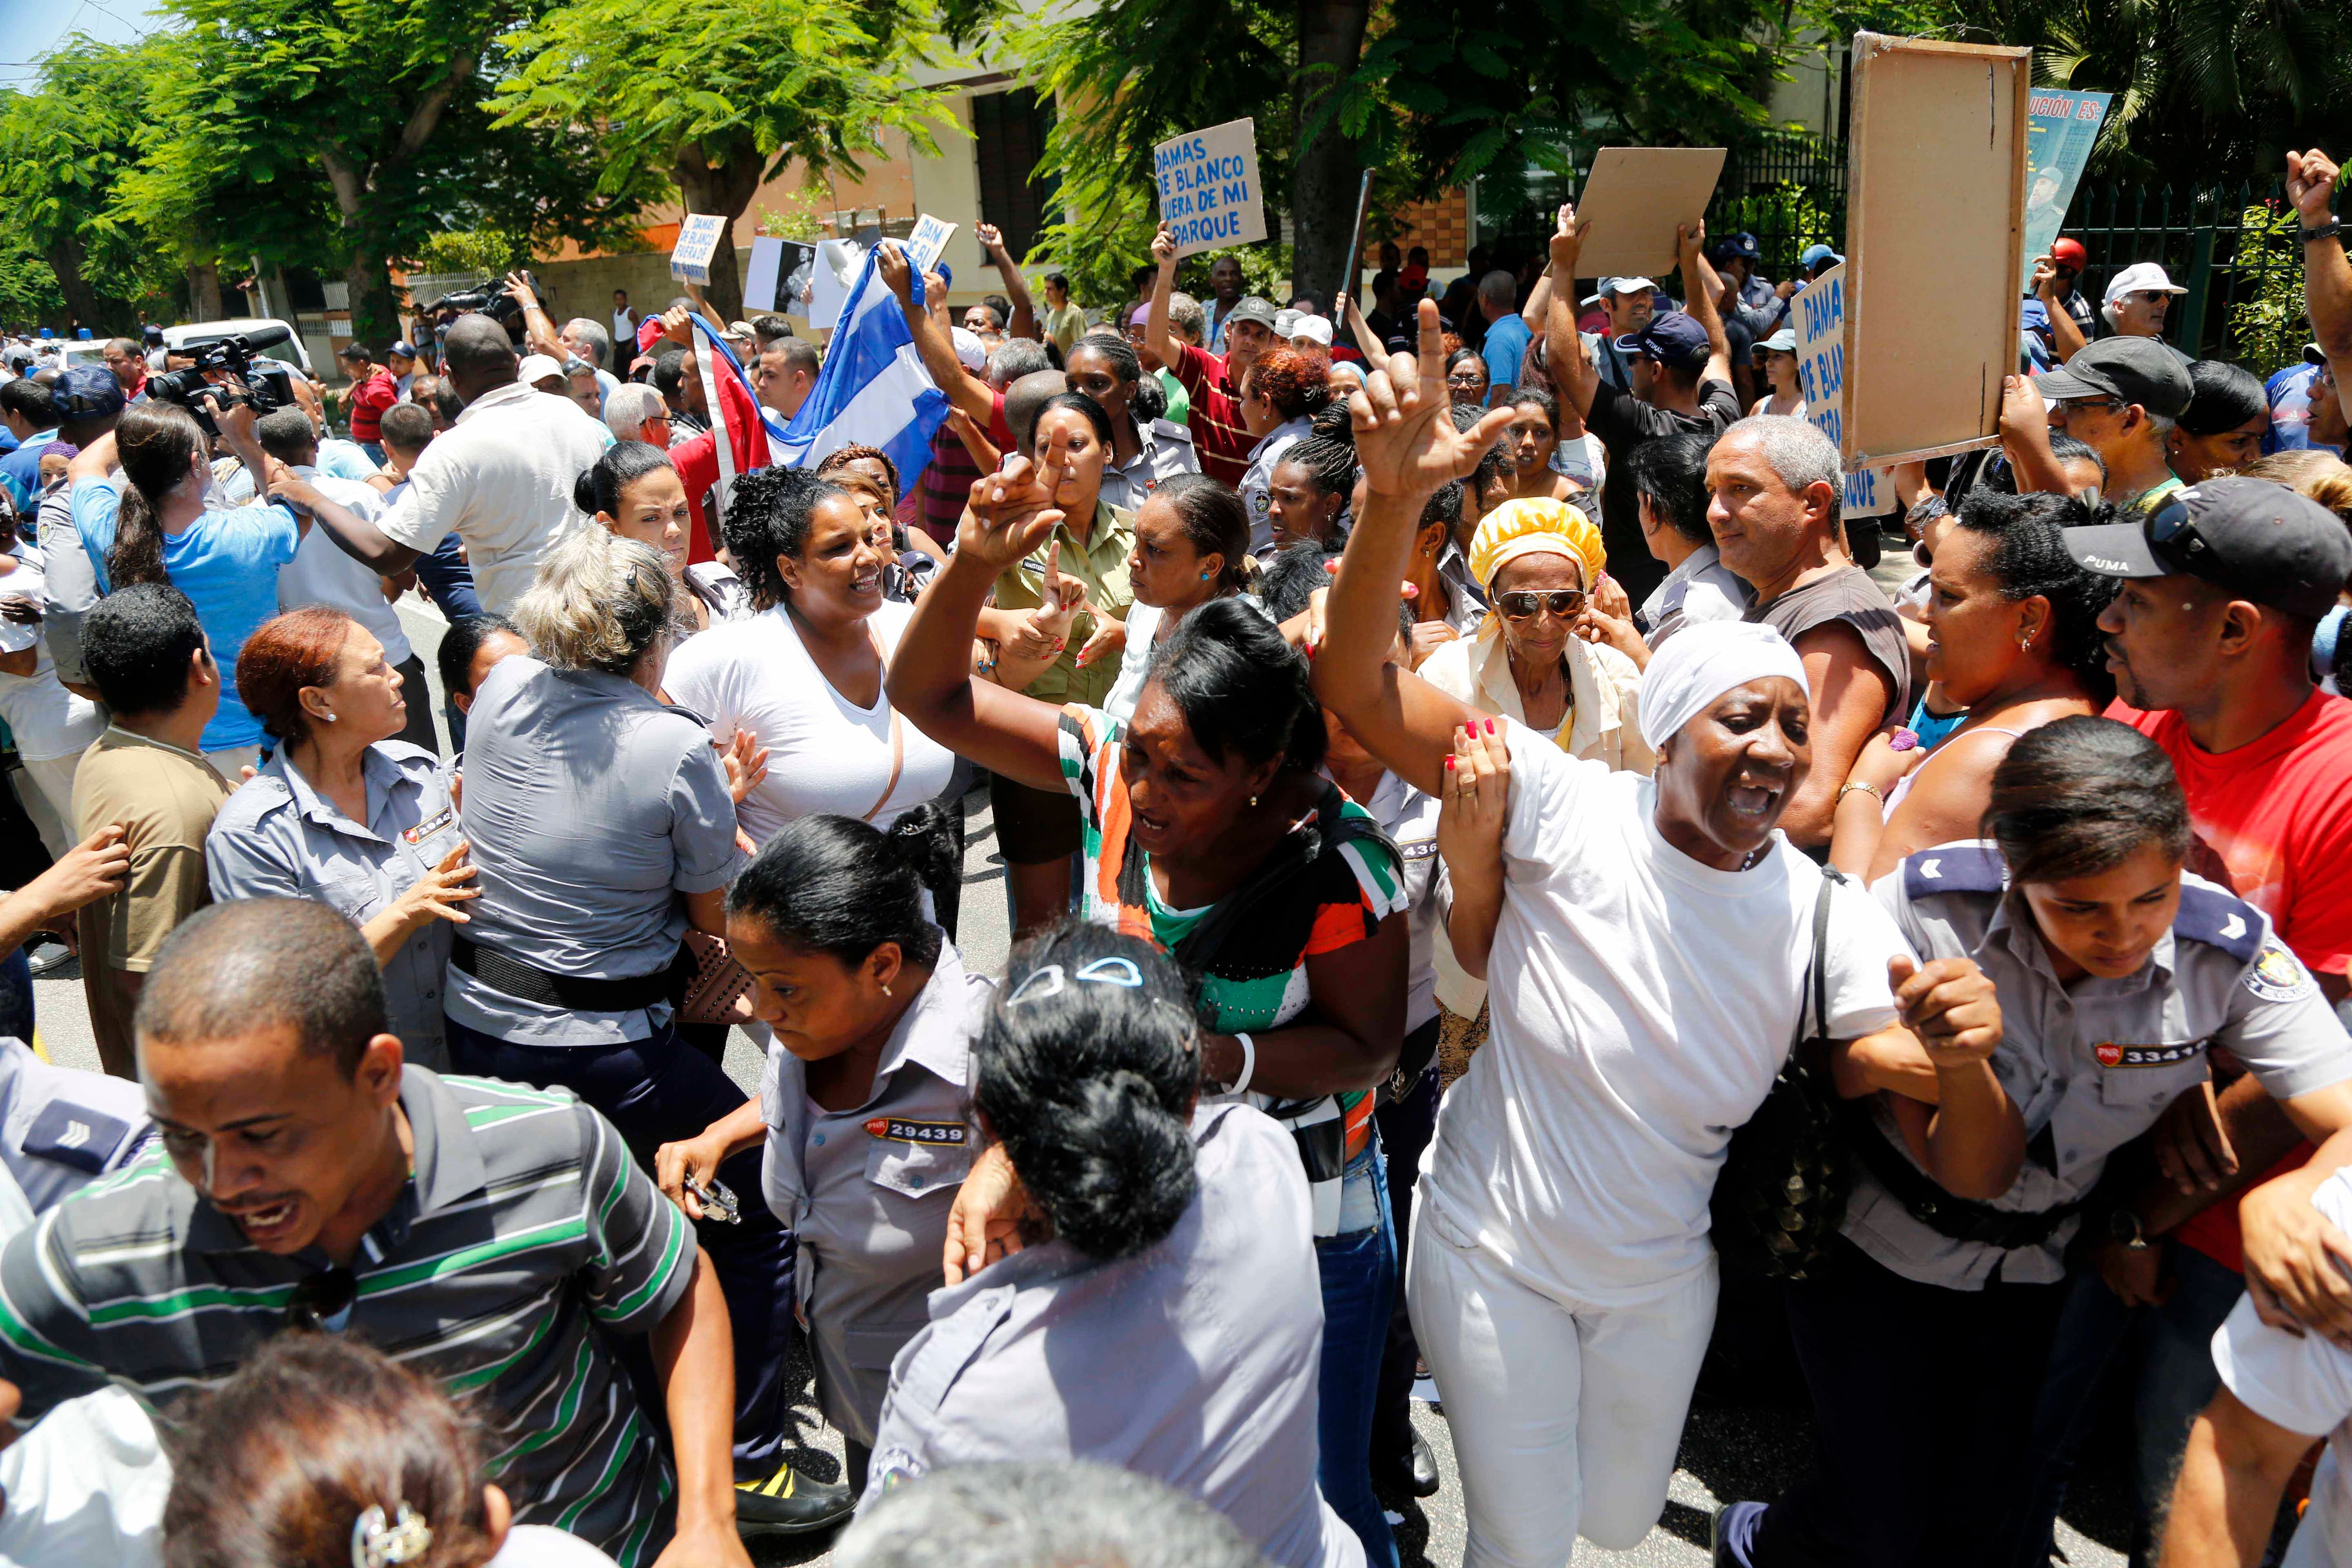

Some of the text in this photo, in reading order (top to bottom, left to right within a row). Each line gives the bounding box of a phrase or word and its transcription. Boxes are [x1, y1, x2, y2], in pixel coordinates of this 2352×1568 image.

[2076, 101, 2102, 120] ES:
[1156, 138, 1207, 173] DAMAS
[1158, 155, 1244, 198] DE BLANCO
[1161, 181, 1248, 221] UERA DE MI
[692, 217, 715, 231] DAMAS
[918, 219, 947, 244] DAM
[1172, 211, 1240, 247] PARQUE
[680, 230, 714, 246] DE BLANCO
[676, 244, 707, 260] FUERA DE
[672, 261, 681, 274] MI
[1804, 278, 1845, 344] DAMA
[1800, 358, 1816, 405] DE
[2083, 555, 2129, 572] PUMA
[2098, 1047, 2120, 1058] PNR
[867, 1121, 963, 1140] PNR 29439
